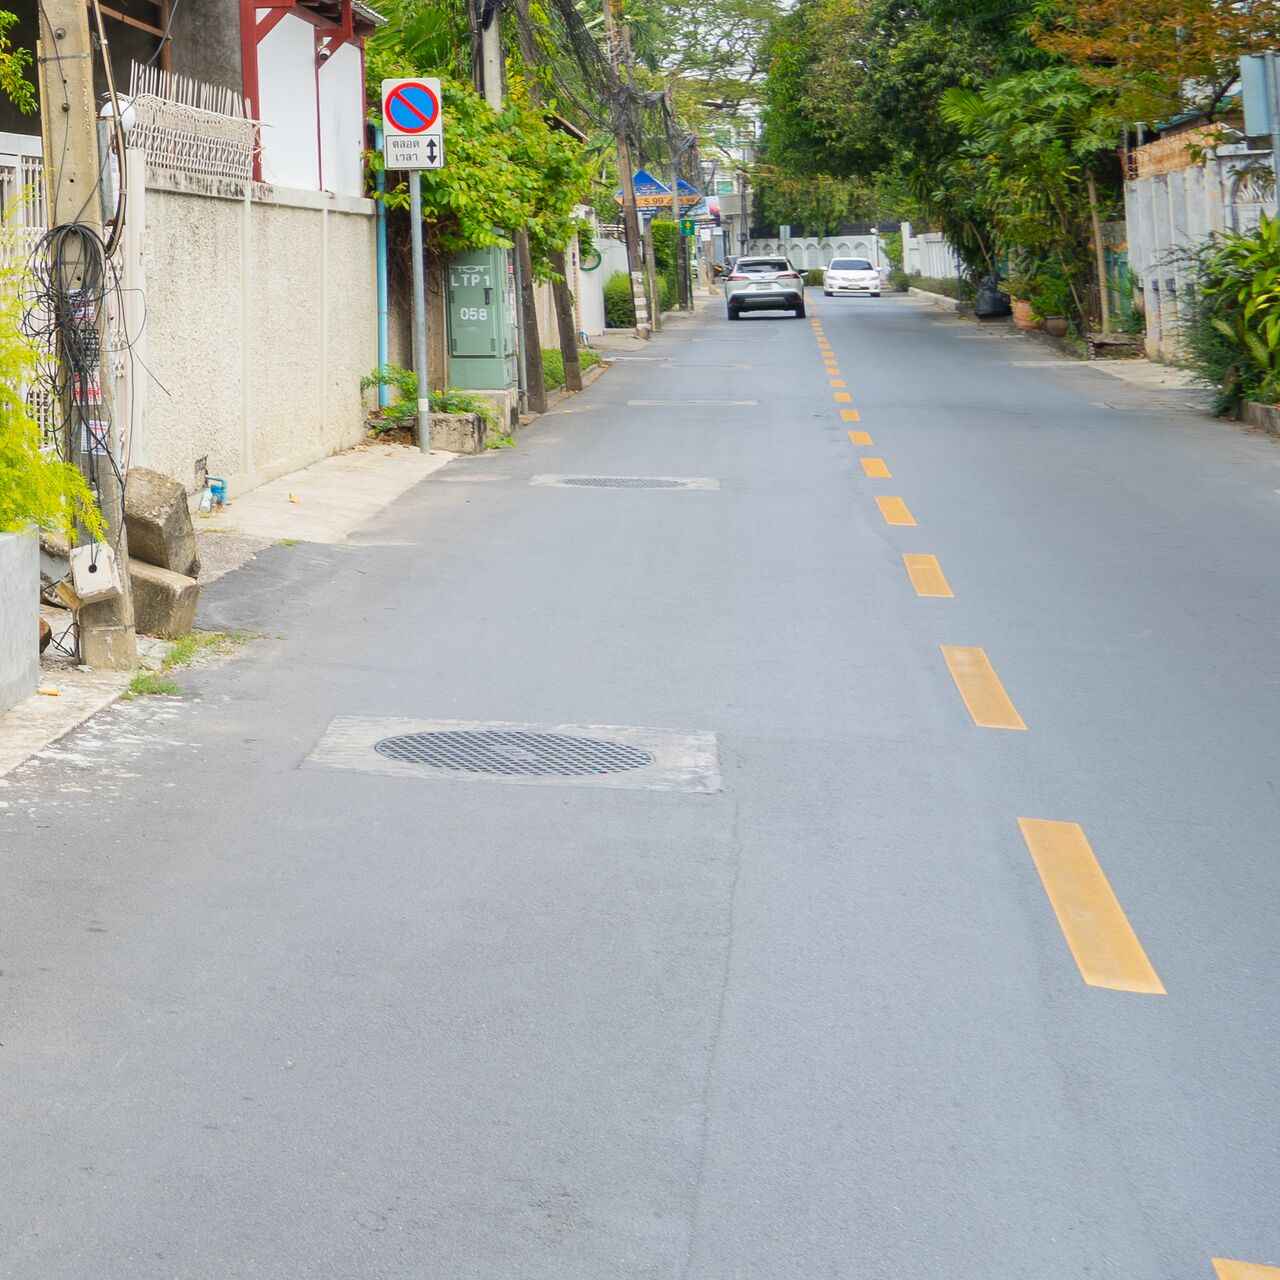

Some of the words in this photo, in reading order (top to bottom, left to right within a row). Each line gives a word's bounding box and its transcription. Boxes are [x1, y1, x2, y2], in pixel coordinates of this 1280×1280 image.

[392, 139, 420, 149] ตลอด
[395, 153, 418, 162] เวลา
[460, 307, 488, 321] 058
